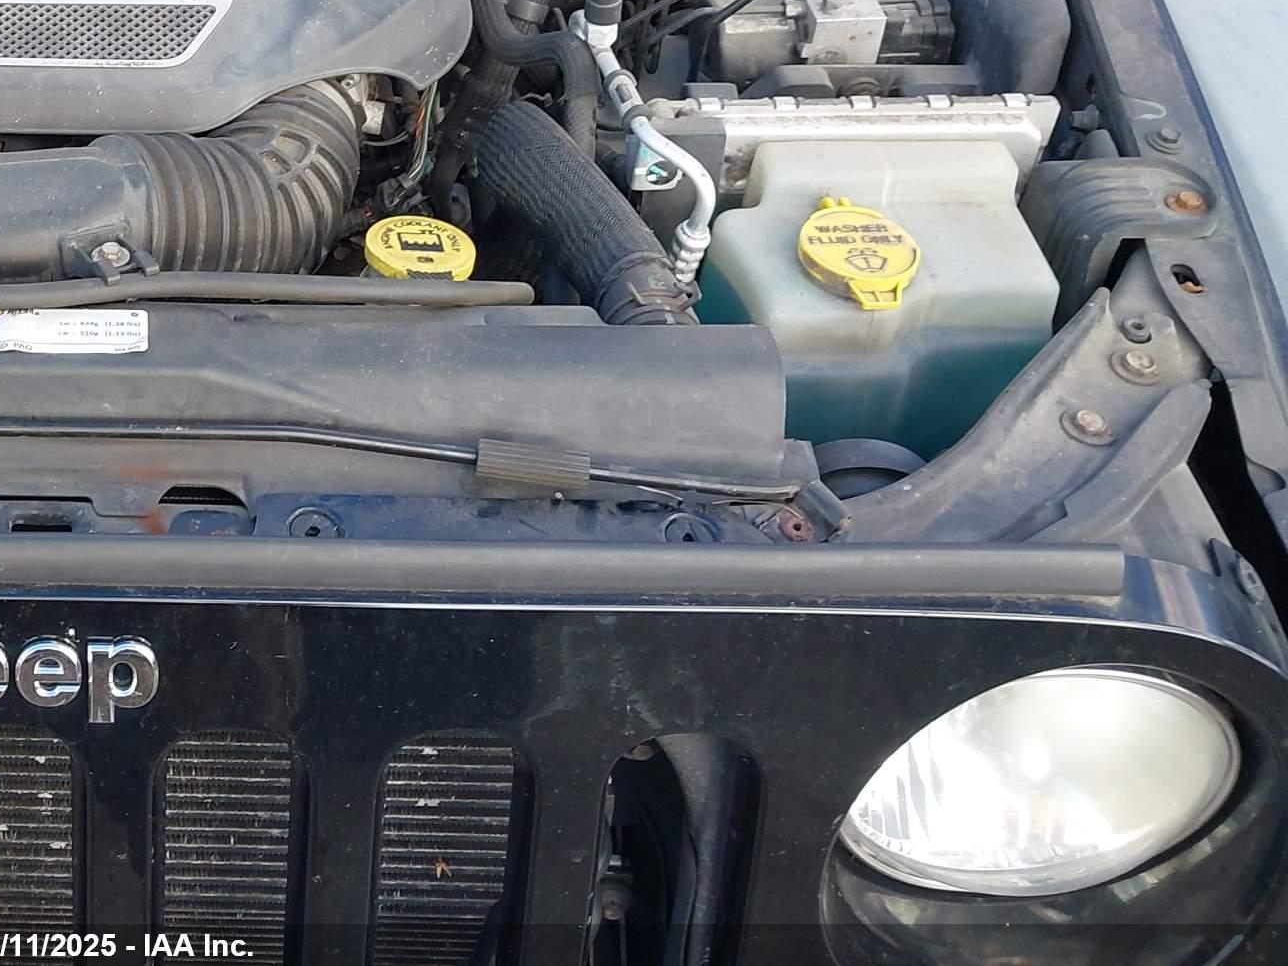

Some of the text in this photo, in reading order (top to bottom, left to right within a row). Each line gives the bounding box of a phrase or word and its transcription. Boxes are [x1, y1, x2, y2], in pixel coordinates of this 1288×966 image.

[814, 223, 889, 234] WASHER
[807, 234, 904, 245] FLUID ONLY
